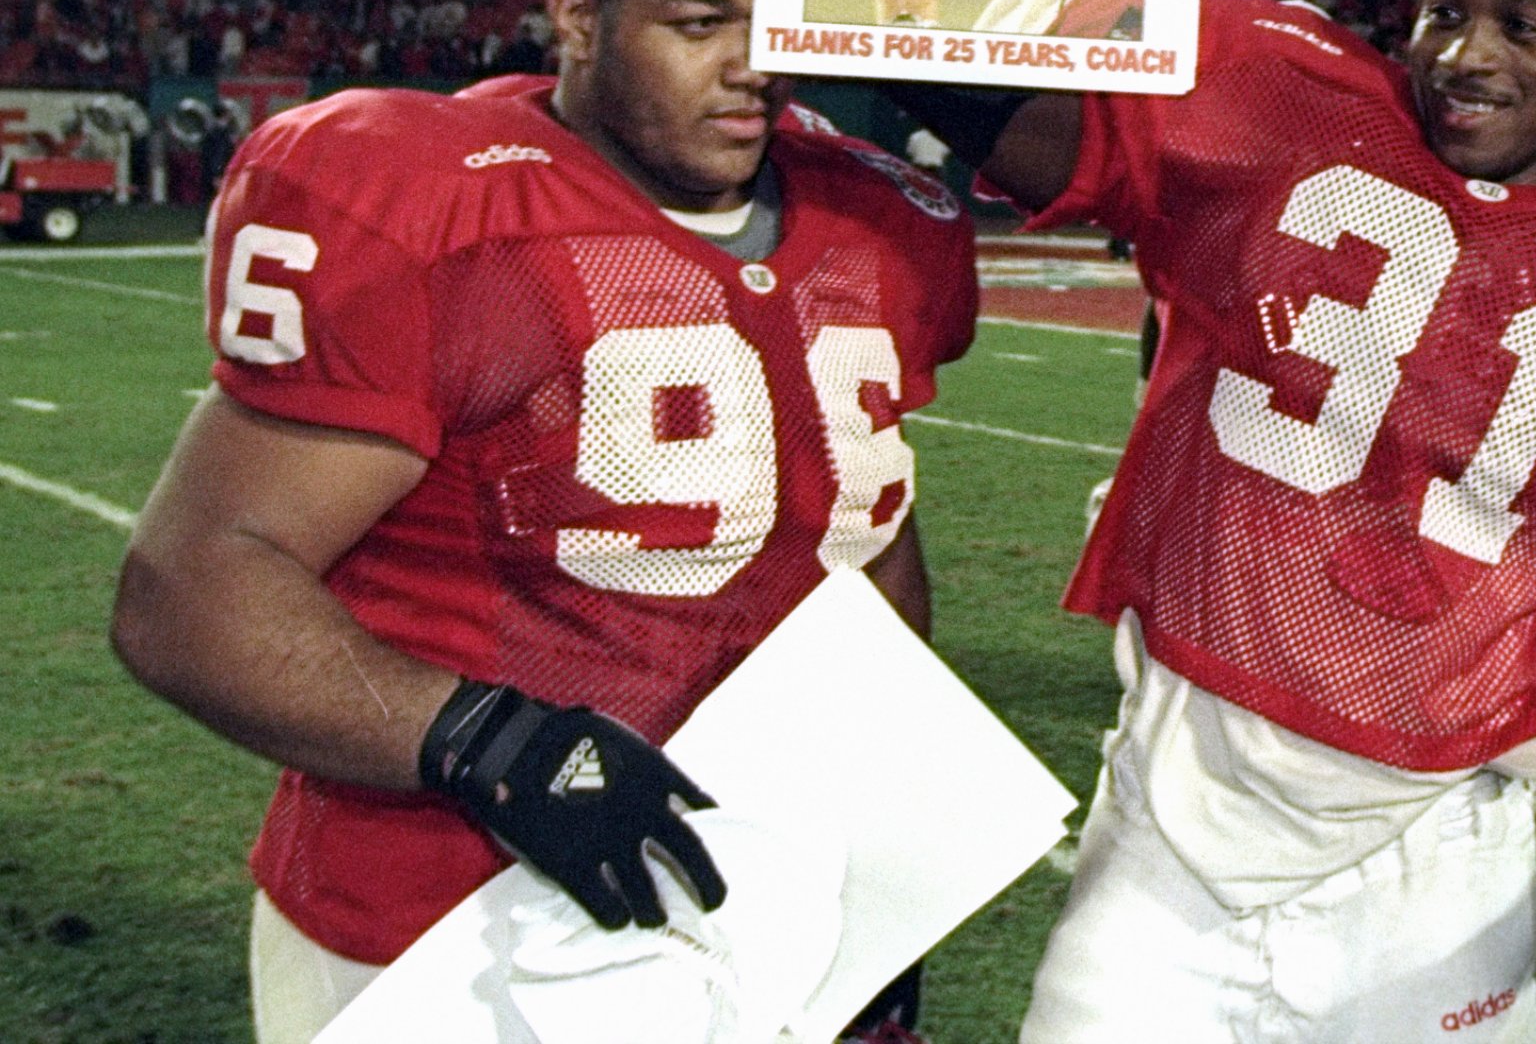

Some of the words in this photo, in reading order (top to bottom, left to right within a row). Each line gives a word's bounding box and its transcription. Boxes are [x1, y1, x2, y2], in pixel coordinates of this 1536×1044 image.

[766, 27, 875, 57] THANKS
[883, 34, 934, 61] FOR
[943, 38, 976, 64] 25
[985, 40, 1076, 73] YEARS,
[1085, 46, 1177, 75] COACH
[463, 143, 553, 169] adidas
[556, 322, 915, 597] 96
[1440, 987, 1517, 1032] adidas
